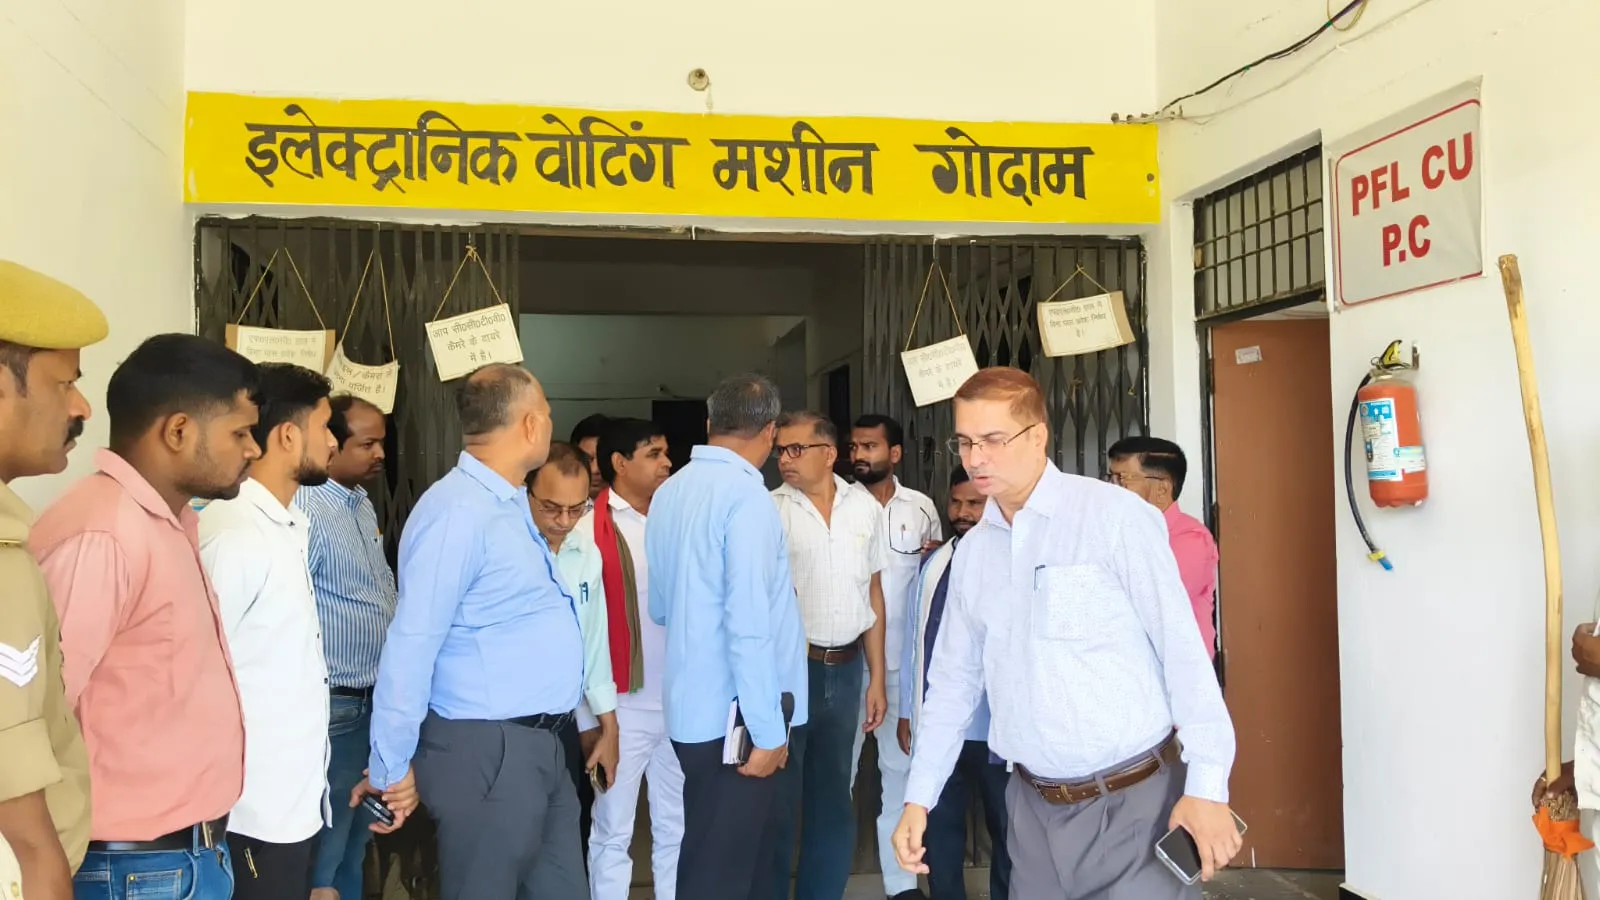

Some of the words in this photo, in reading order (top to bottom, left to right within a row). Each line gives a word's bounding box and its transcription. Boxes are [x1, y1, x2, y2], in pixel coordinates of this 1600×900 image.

[525, 113, 690, 190] वोटिंग
[710, 121, 880, 196] मशीन
[914, 126, 1094, 206] गोदाम
[1351, 161, 1411, 216] PFL
[1421, 133, 1474, 191] CU
[1383, 215, 1431, 268] P.C
